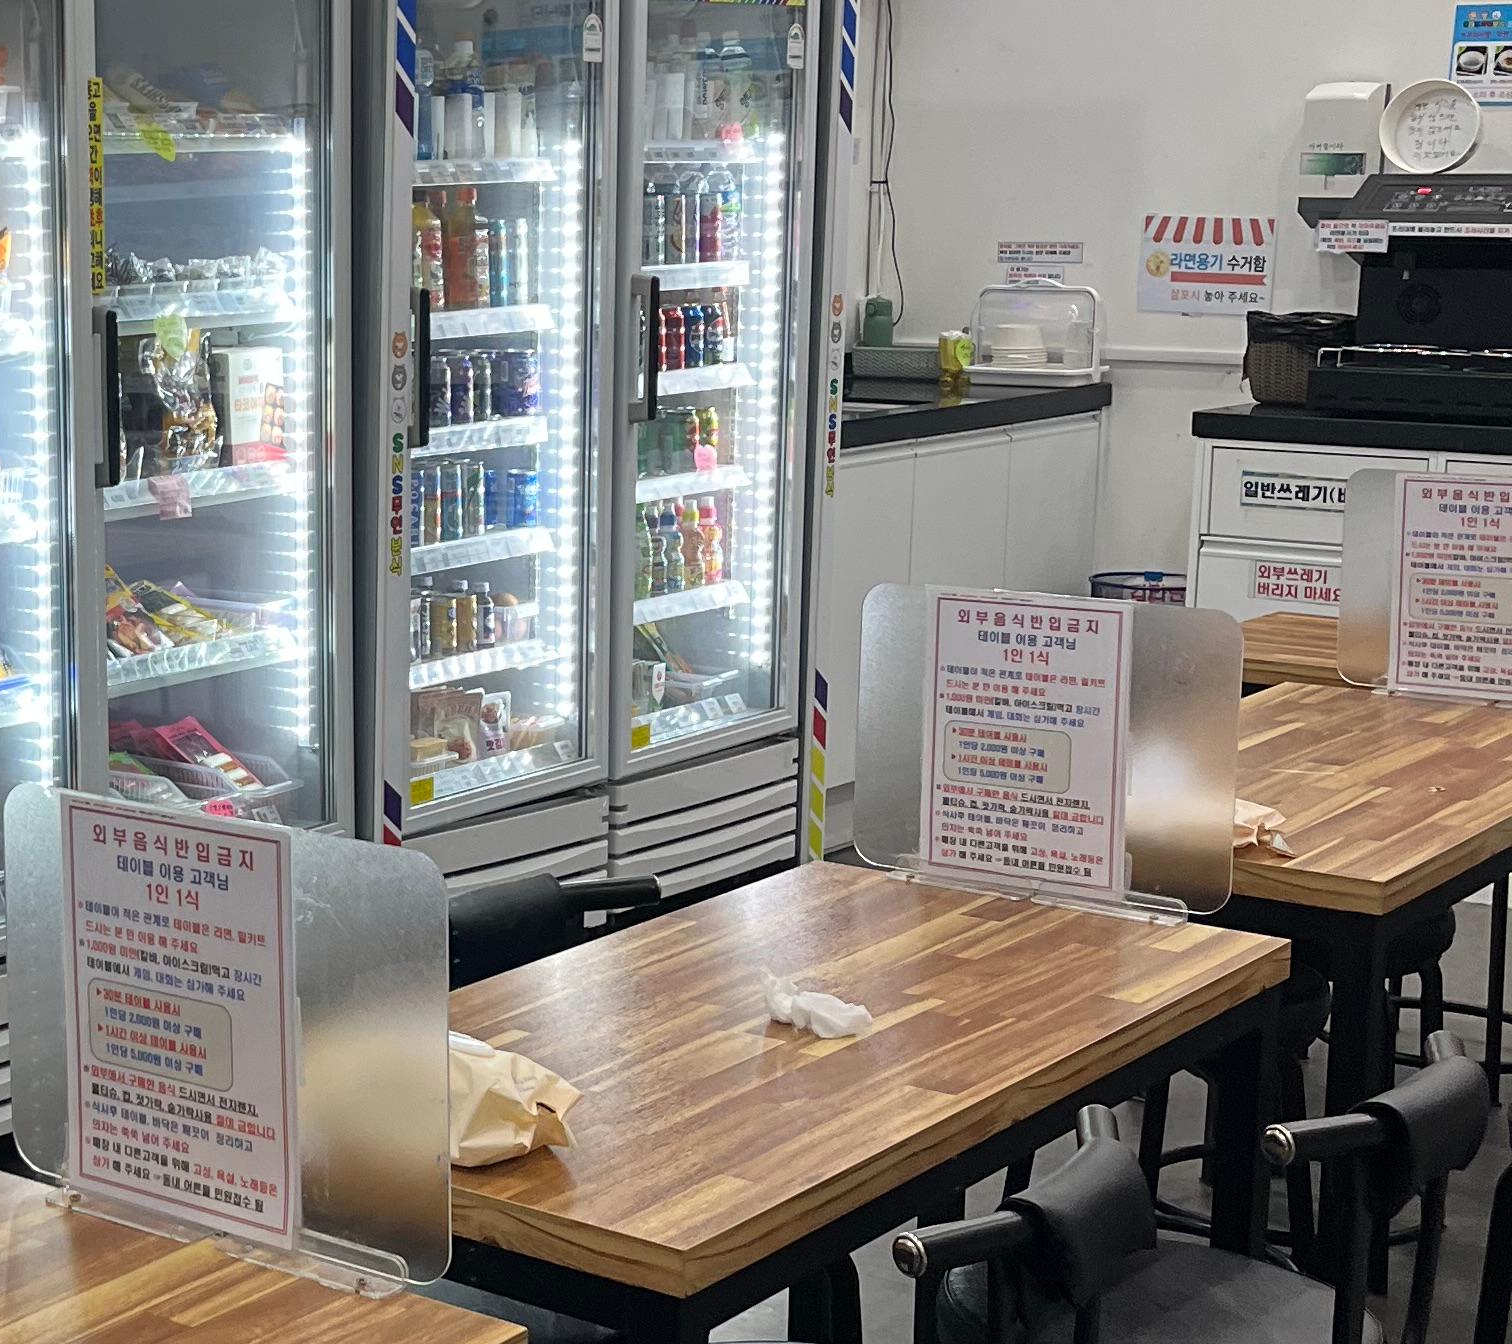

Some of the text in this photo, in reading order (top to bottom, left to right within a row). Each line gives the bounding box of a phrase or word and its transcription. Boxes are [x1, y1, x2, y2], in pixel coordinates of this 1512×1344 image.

[1170, 252, 1266, 273] 라면용기 수거함
[1170, 288, 1200, 301] 살포시
[1204, 290, 1225, 303] 놓아
[390, 432, 404, 577] SNS 무인분식
[1257, 565, 1328, 585] 외부쓰레기
[1257, 582, 1298, 600] 버리지
[977, 630, 1077, 650] 테이블 이용 고객님
[1002, 648, 1050, 665] 1인 1식
[117, 855, 229, 891] 테이블 이용 고객님
[145, 883, 200, 910] 1인 1식
[171, 937, 199, 954] 주세요
[217, 983, 245, 1001] 주세요
[162, 1136, 190, 1154] 주세요
[124, 1163, 151, 1181] 주세요
